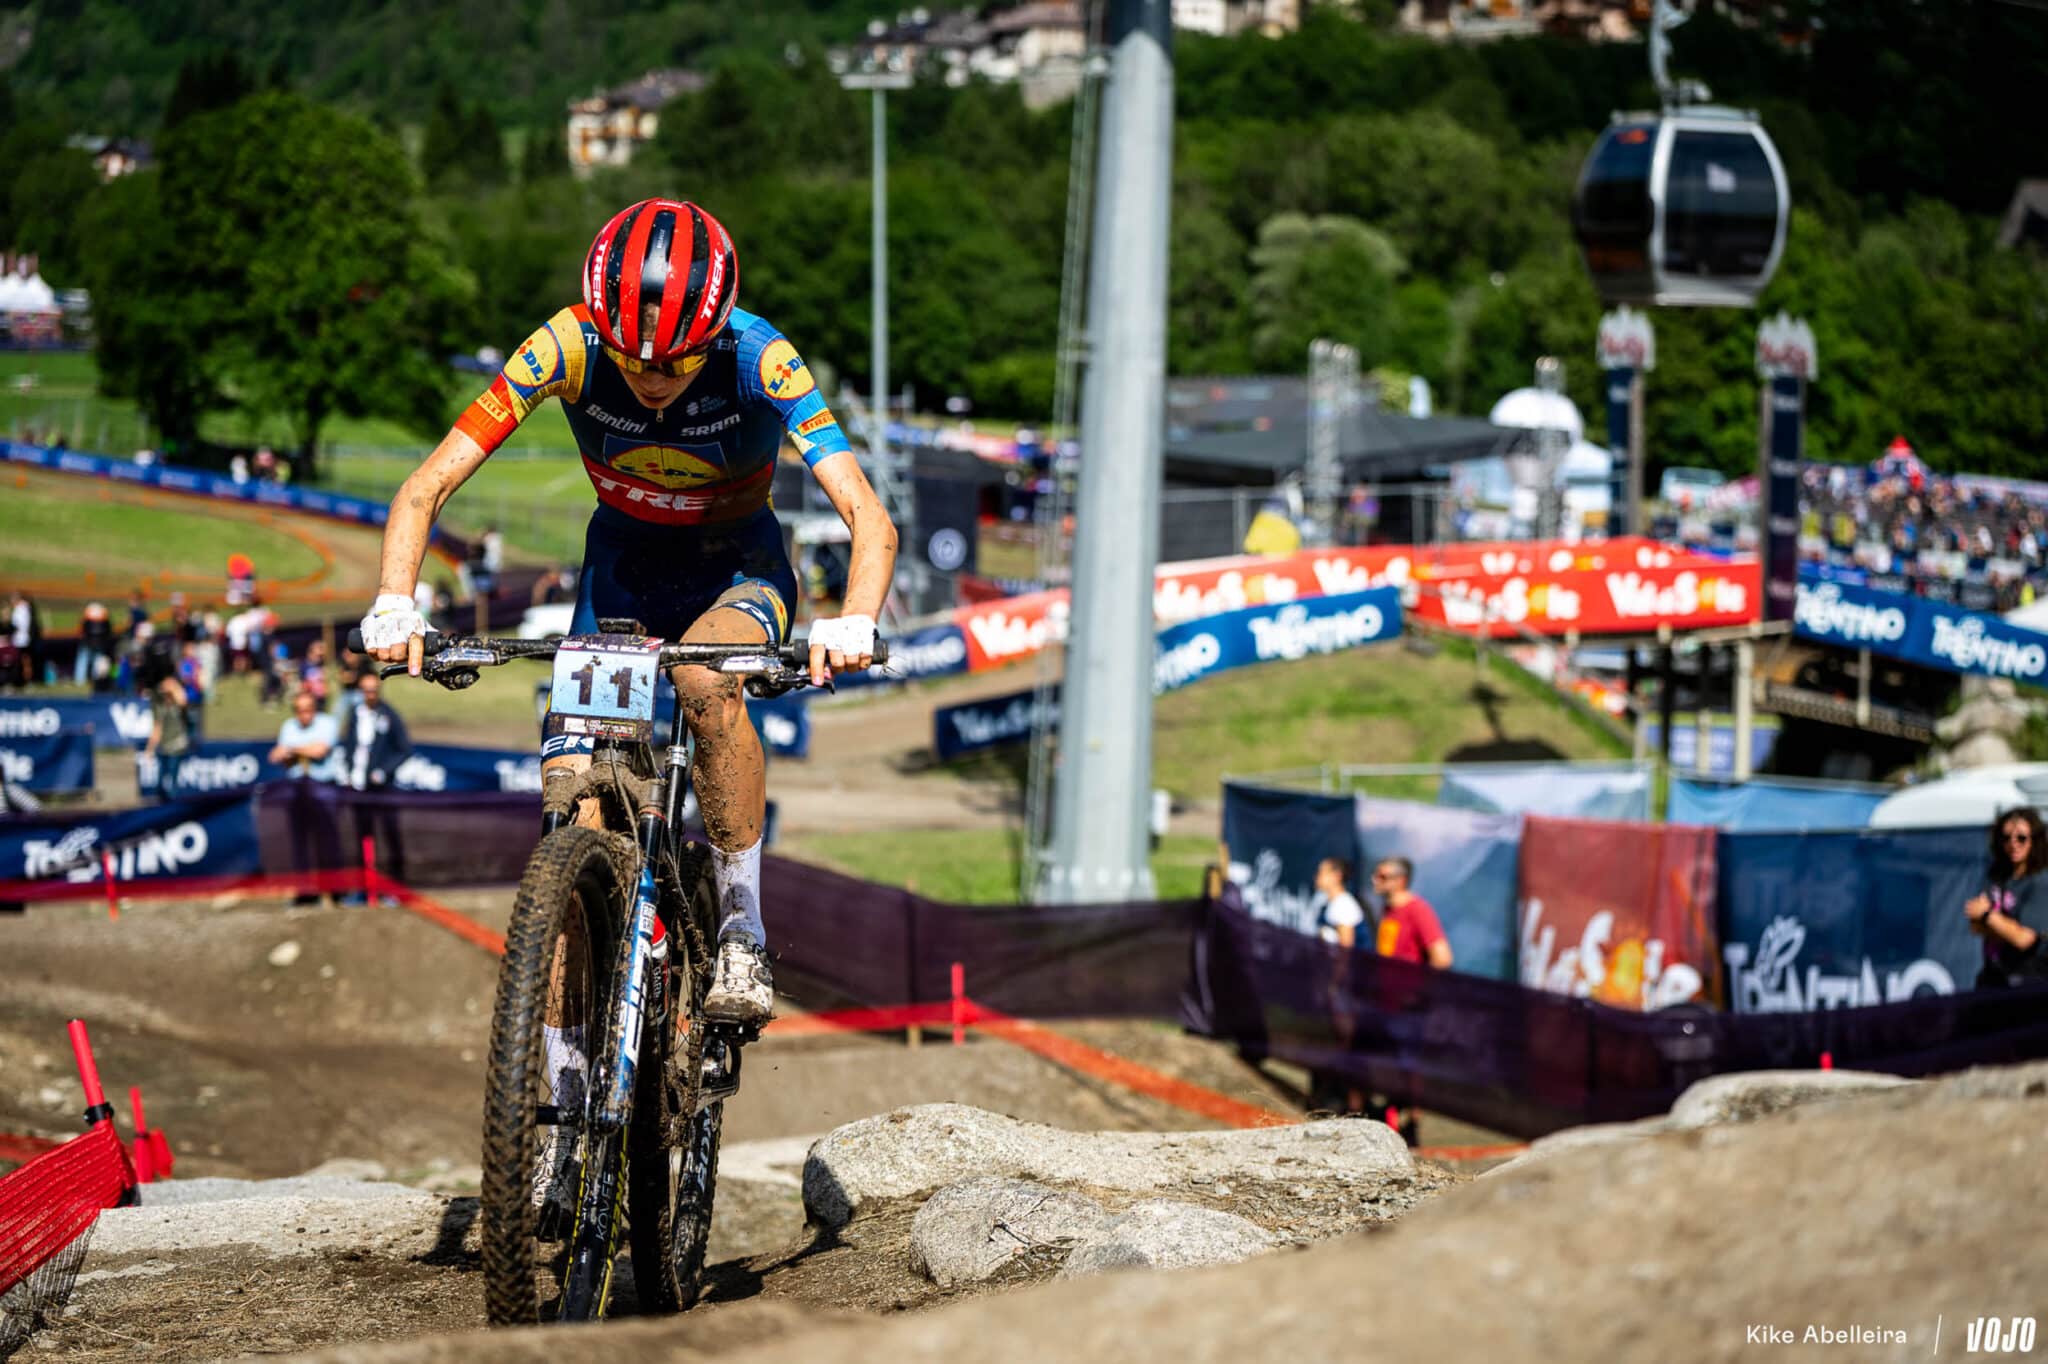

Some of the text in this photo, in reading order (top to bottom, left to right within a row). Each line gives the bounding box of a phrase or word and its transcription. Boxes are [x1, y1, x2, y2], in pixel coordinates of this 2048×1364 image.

[592, 240, 609, 312] TREK
[700, 248, 724, 319] TREK
[585, 403, 649, 434] Santini
[681, 412, 741, 437] SRAM
[591, 471, 722, 511] TRE
[571, 664, 633, 709] 11
